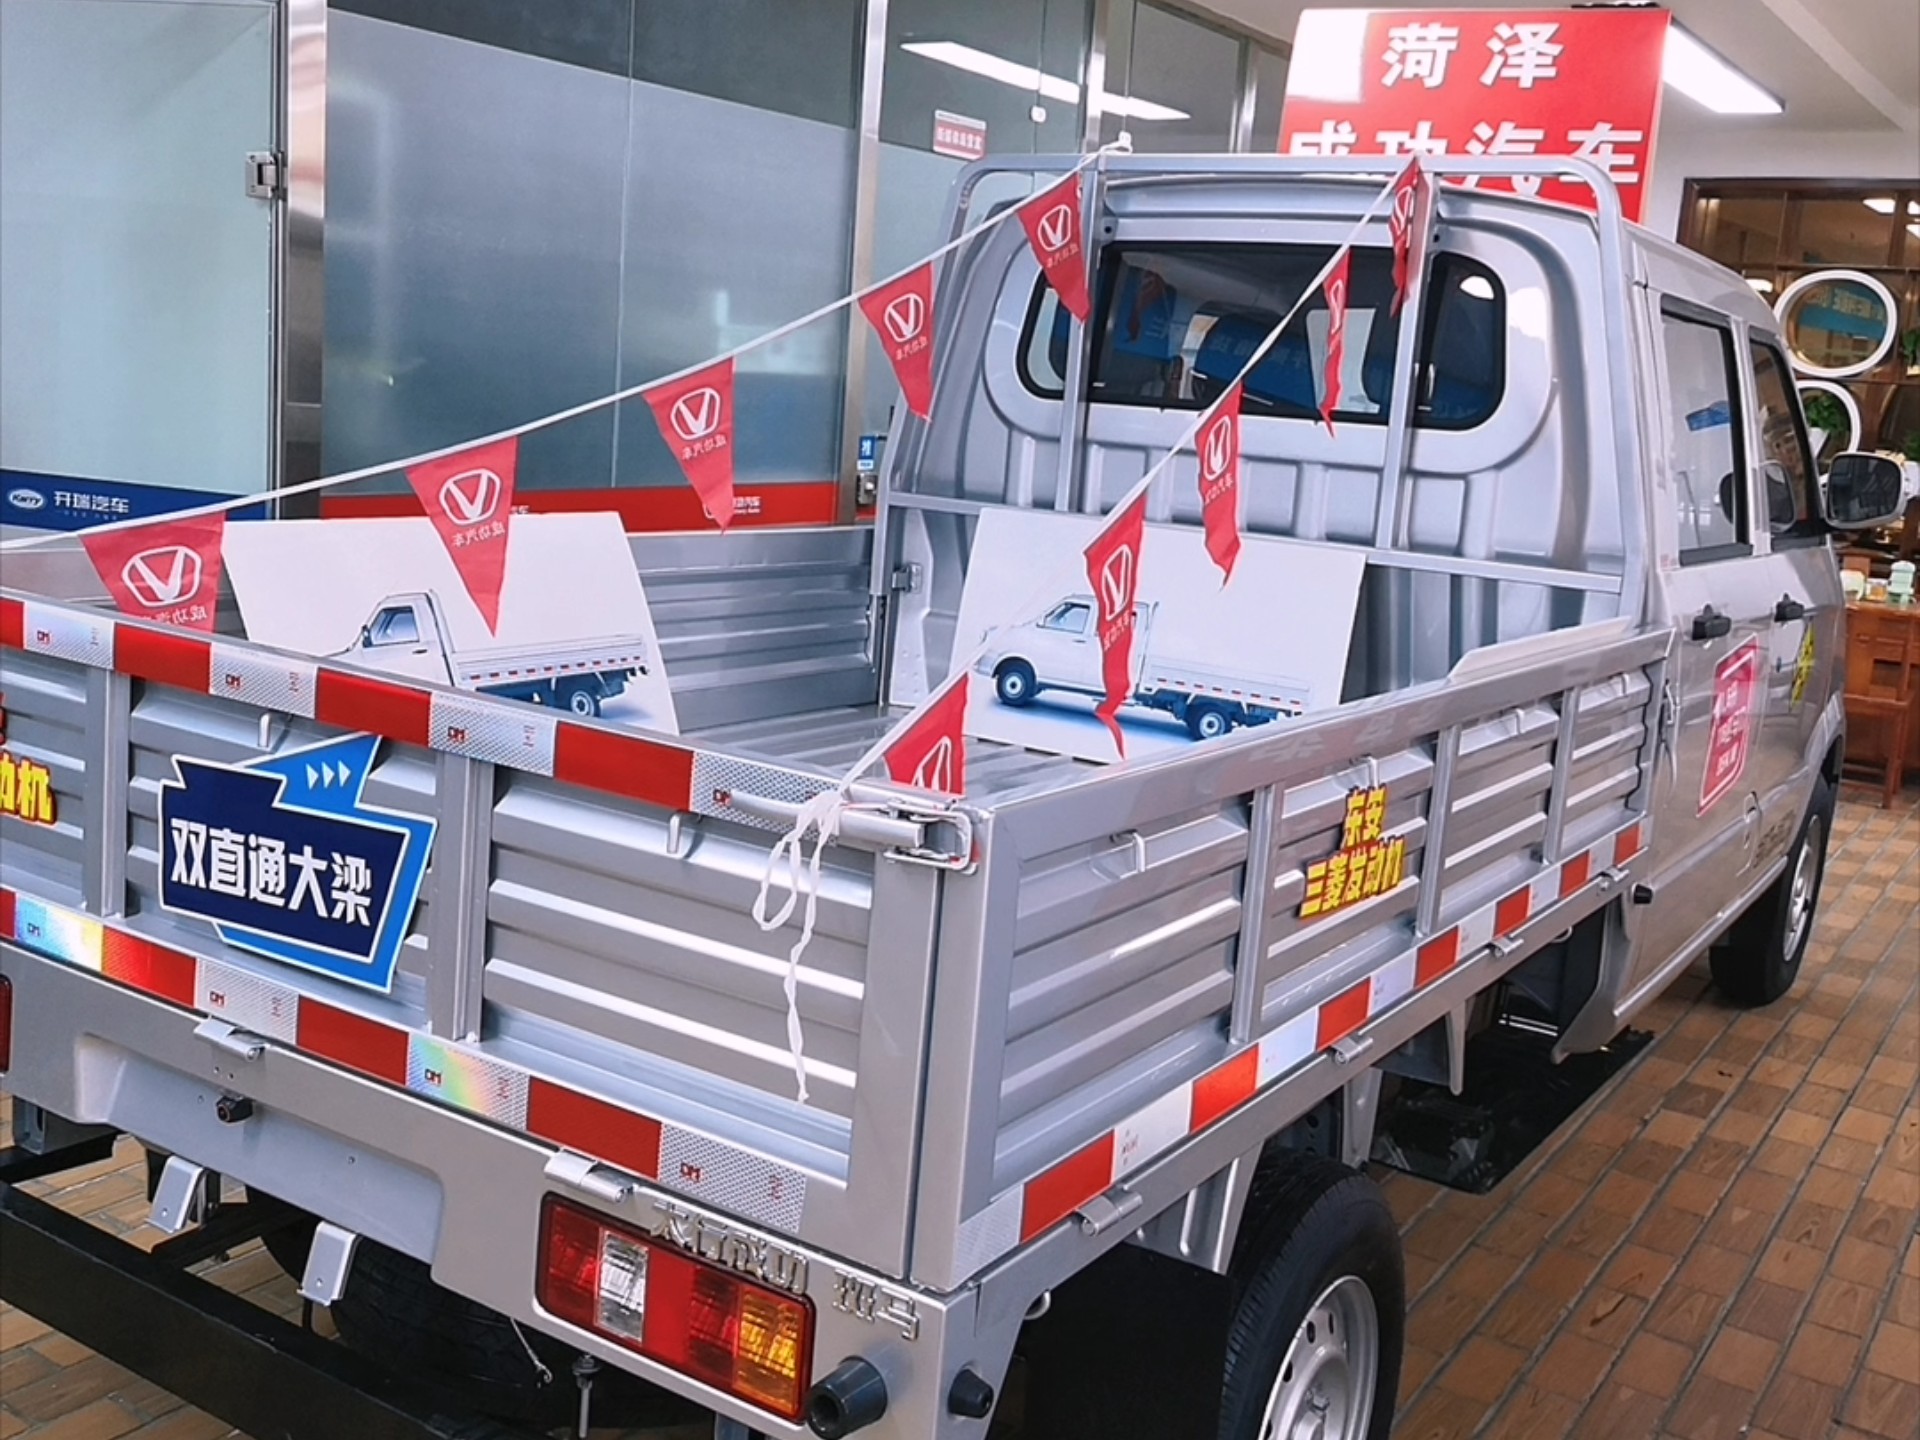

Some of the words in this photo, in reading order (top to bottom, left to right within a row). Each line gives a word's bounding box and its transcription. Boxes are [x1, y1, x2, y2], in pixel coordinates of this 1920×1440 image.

[1380, 21, 1564, 89] 菏泽
[54, 490, 130, 513] 开瑞汽车
[170, 817, 373, 927] 双直通大梁
